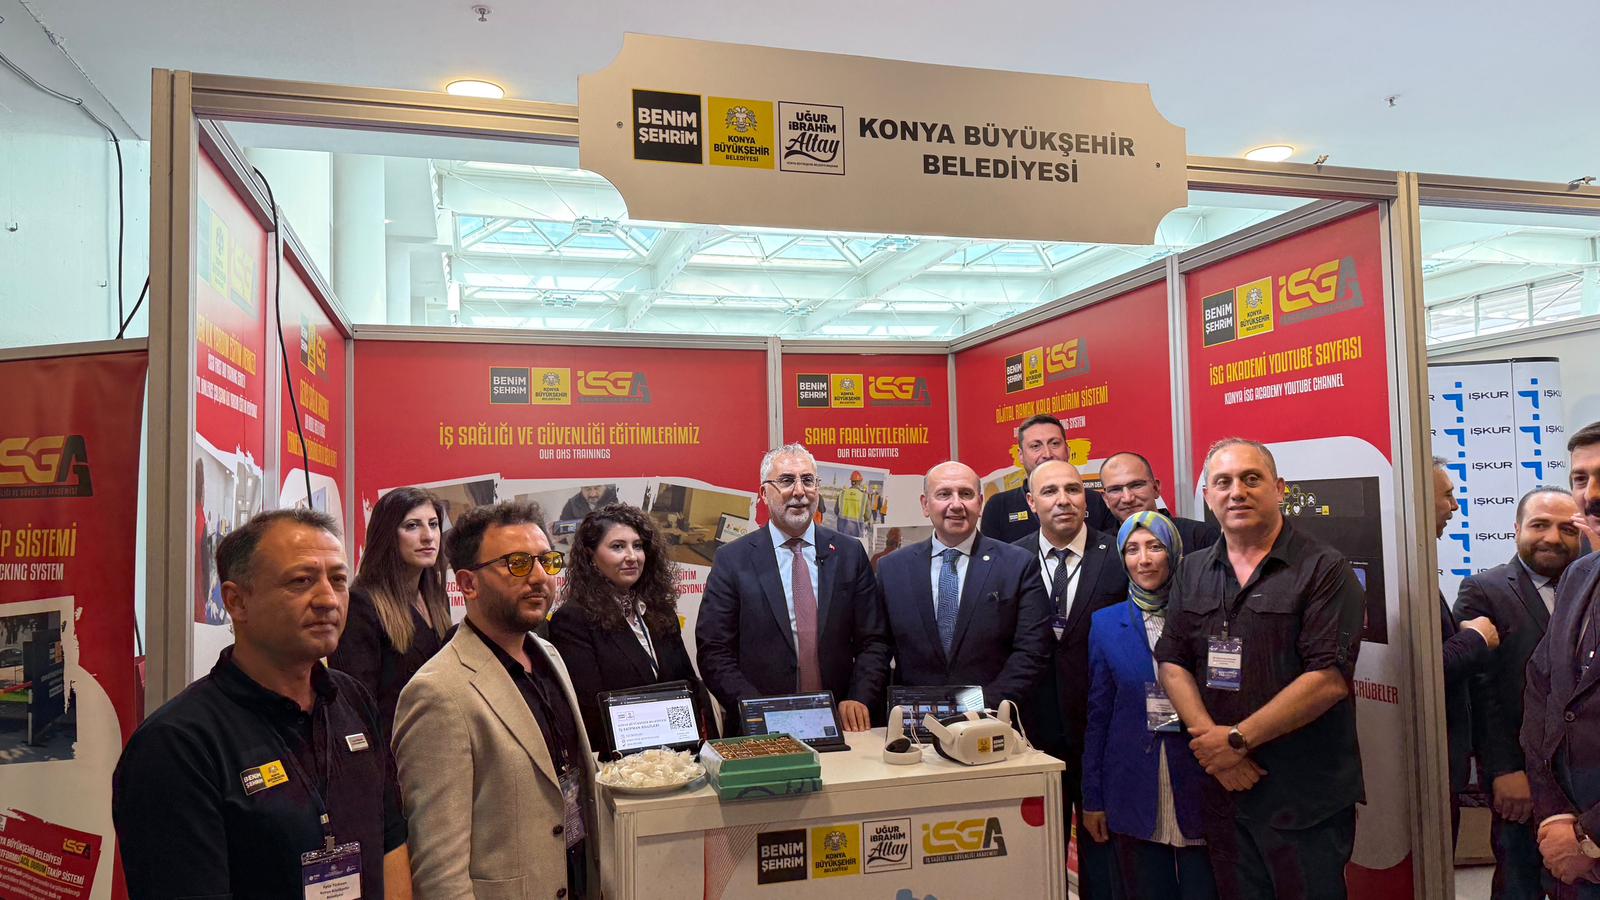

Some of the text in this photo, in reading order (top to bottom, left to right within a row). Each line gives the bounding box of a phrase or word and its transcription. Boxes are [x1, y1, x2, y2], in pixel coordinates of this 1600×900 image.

[796, 110, 828, 123] UĞUR
[728, 135, 755, 144] KONYA
[784, 132, 840, 162] Altay
[859, 117, 1135, 157] KONYA BÜYÜKŞEHİR
[714, 144, 770, 156] BÜYÜKŞEHİR
[923, 154, 1078, 183] BELEDİYESİ
[1210, 336, 1362, 386] İSG AKADEMİ YOUTUBE SAYFASI
[1082, 380, 1108, 408] SİSTEMİ
[1225, 373, 1344, 404] KONYA İSG ACADEMY YOUTUBE CHANNEL
[440, 422, 700, 449] İŞ SAĞLIĞI VE GÜVENLİĞİ EĞİTİMLERİMİZ
[805, 424, 928, 445] SAHA FAALİYETLERİMİZ
[539, 448, 611, 460] OUR OHS TRAININGS
[838, 447, 899, 458] OUR FIELD ACTIVITIES
[16, 522, 76, 558] SİSTEMİ
[0, 563, 64, 580] CKING SYSTEM
[876, 825, 900, 834] UĞUR
[867, 841, 908, 864] Altay
[62, 871, 85, 886] SİSTEMİ
